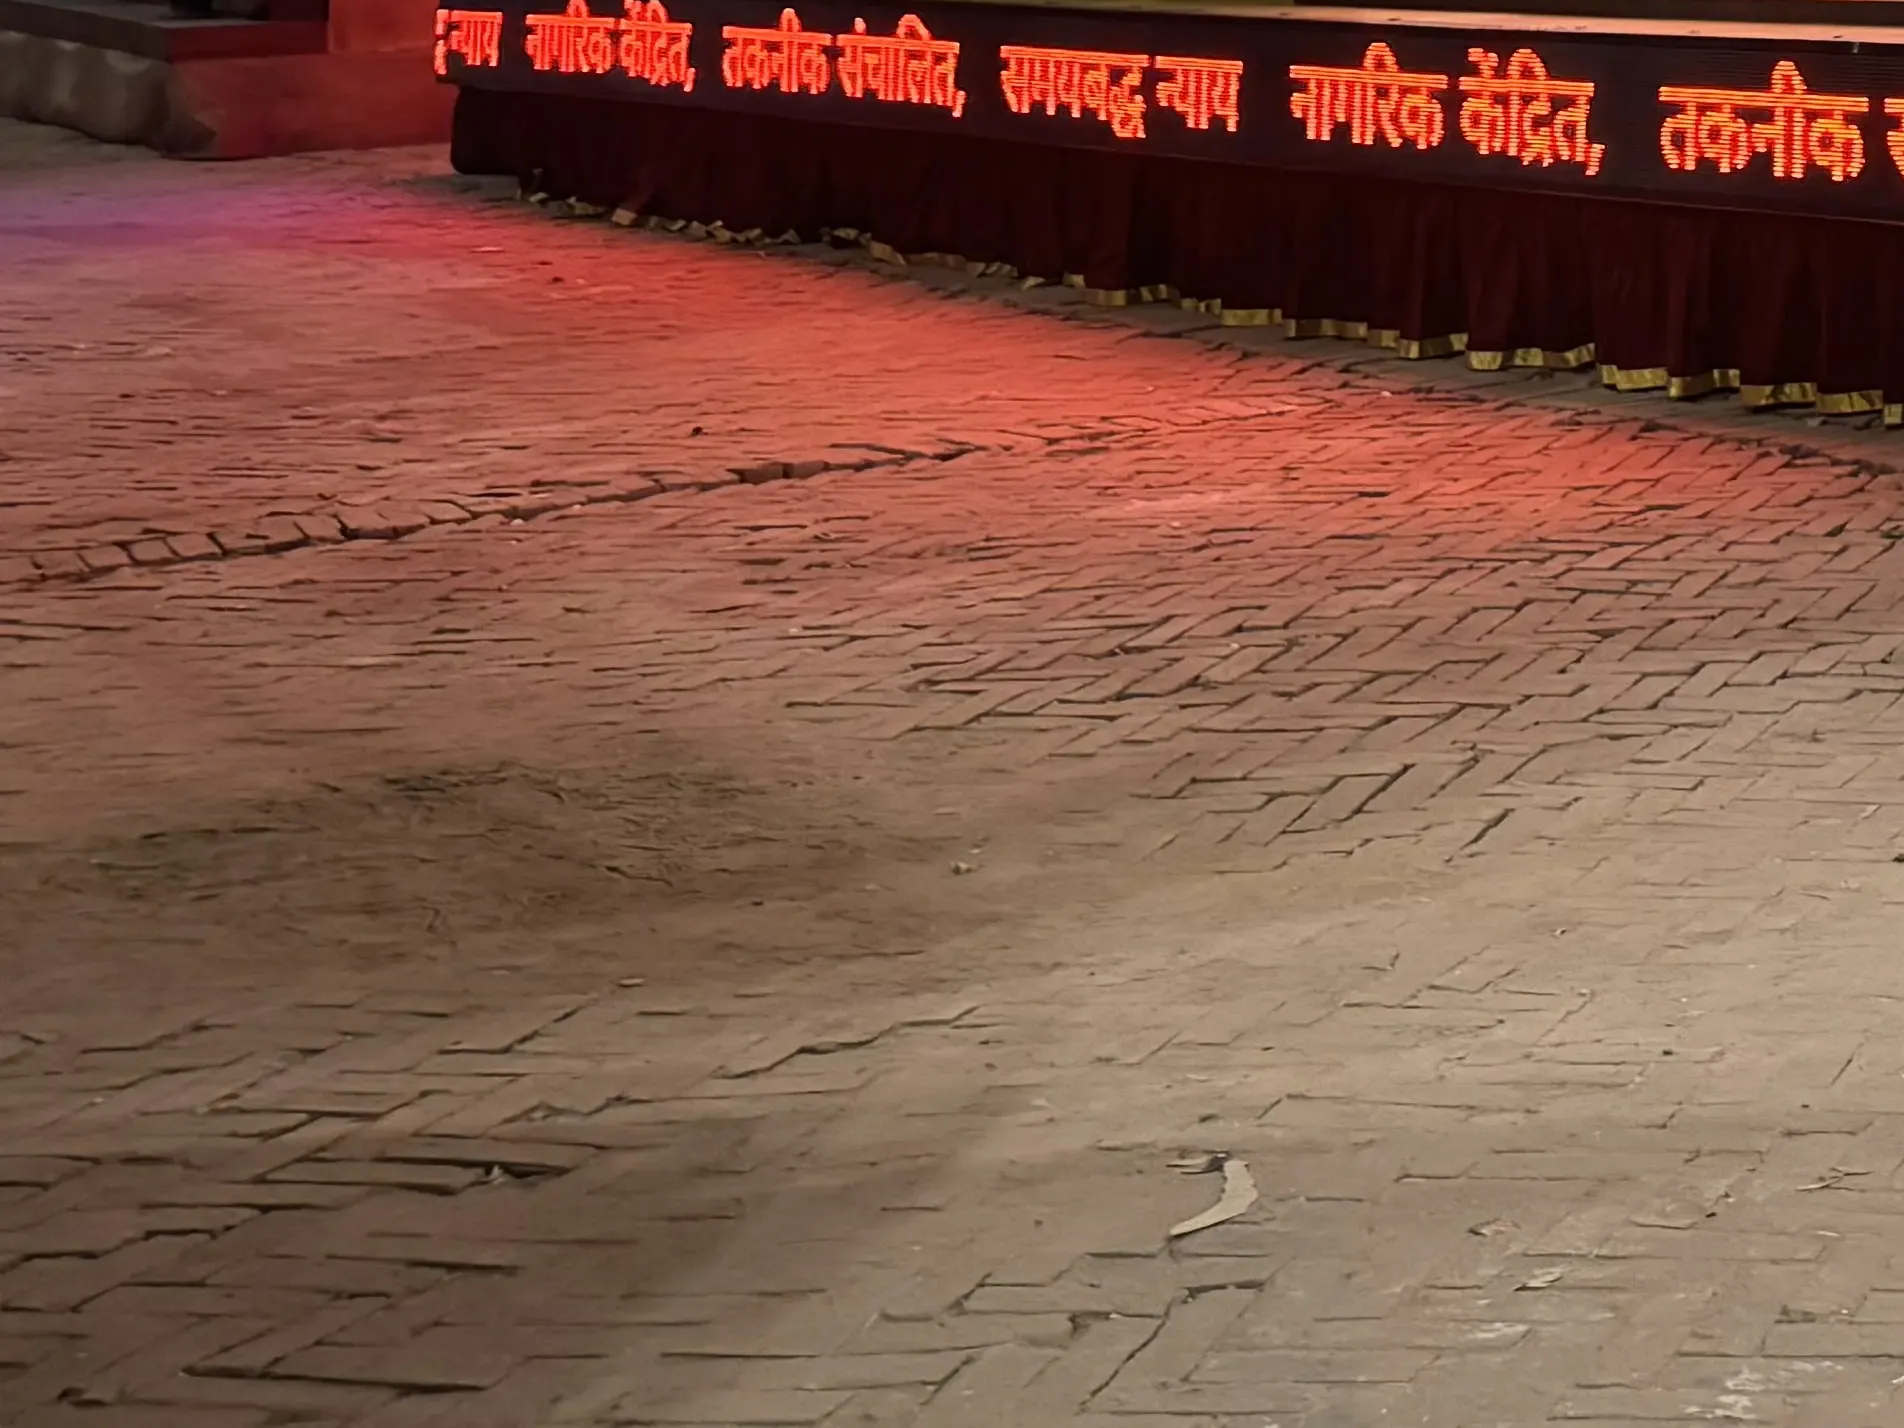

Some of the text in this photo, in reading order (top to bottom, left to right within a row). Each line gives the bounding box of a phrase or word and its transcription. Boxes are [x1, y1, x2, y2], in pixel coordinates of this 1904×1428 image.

[721, 7, 833, 95] तकनीक
[1000, 45, 1150, 140] समयबद्ध
[1154, 55, 1245, 133] न्याय
[1288, 41, 1449, 151] नागरिक
[1657, 59, 1870, 182] तकनीक
